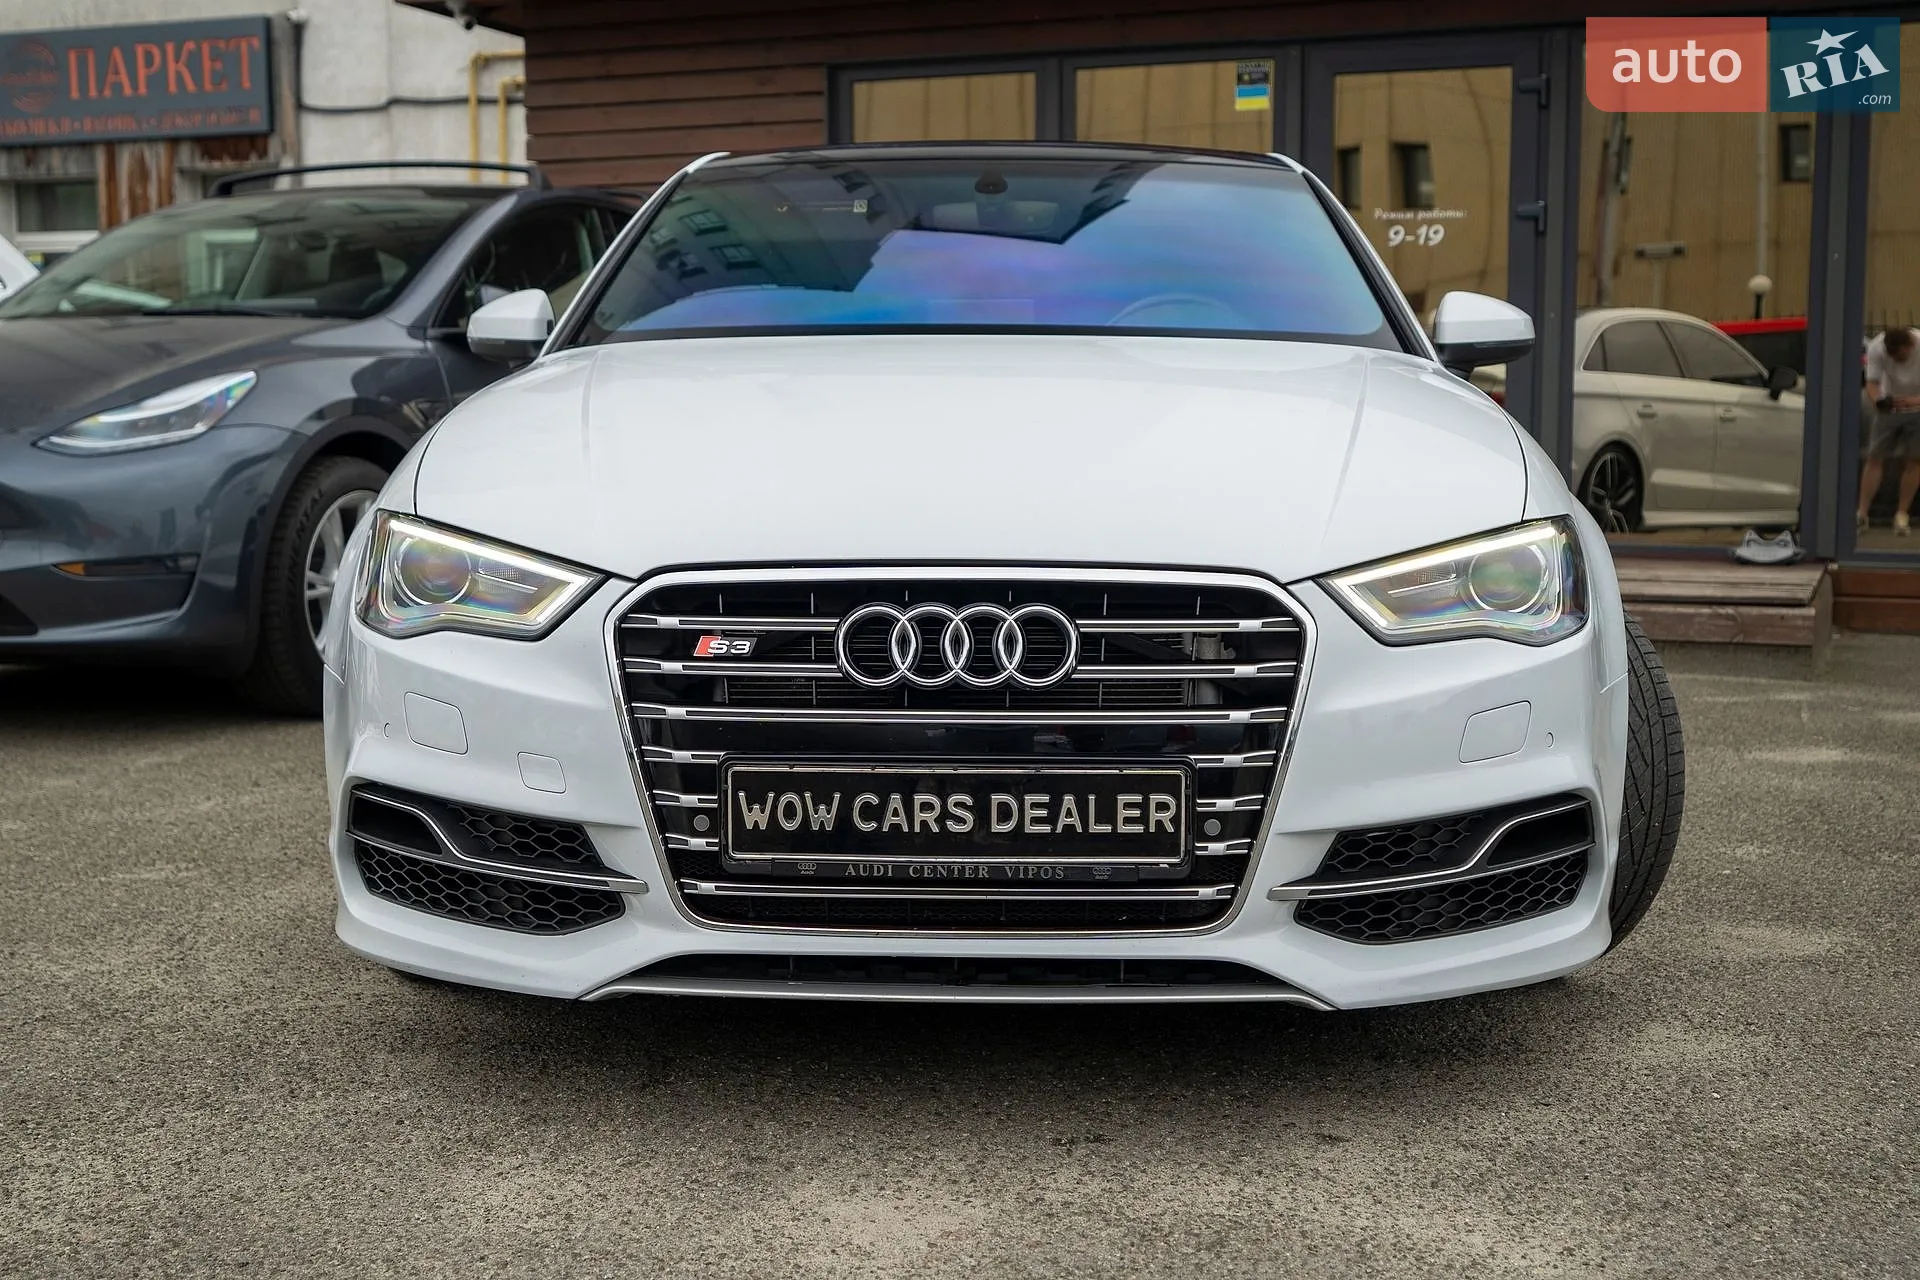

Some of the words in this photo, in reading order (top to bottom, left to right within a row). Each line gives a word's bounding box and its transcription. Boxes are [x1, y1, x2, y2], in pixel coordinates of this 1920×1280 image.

[67, 35, 260, 100] ПАРКЕТ
[1388, 224, 1445, 248] 9-19
[708, 640, 751, 654] S3
[738, 790, 842, 832] WOW
[852, 792, 975, 834] CARS
[990, 792, 1178, 834] DEALER
[845, 864, 893, 876] AUDI
[908, 865, 990, 878] CENTER
[1004, 866, 1065, 879] VIPOS
